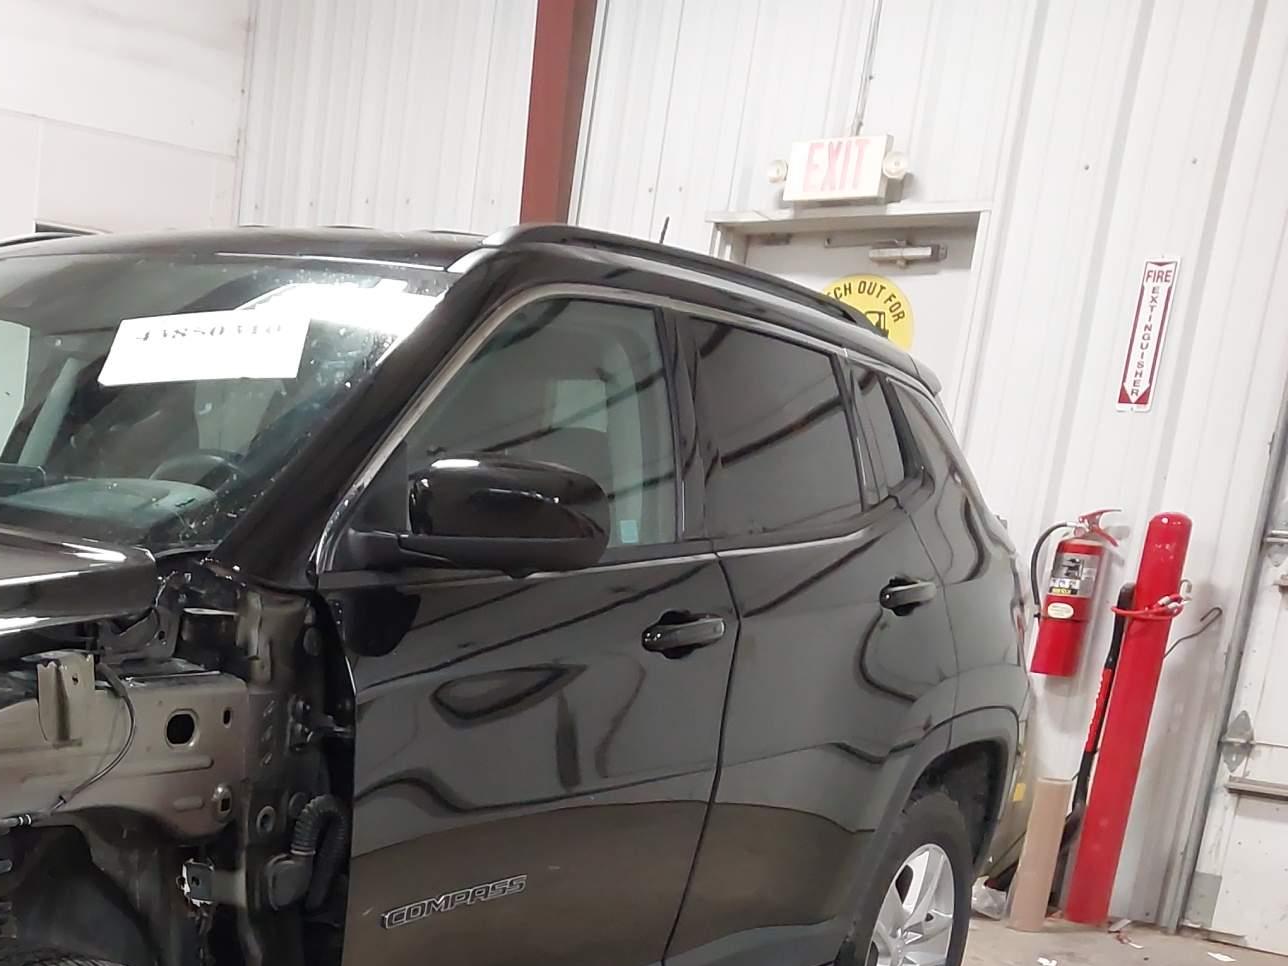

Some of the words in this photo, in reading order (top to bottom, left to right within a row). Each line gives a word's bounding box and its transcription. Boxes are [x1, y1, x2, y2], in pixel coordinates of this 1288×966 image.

[803, 139, 871, 193] EXIT
[858, 280, 886, 299] OUT
[884, 293, 906, 323] FOR
[1145, 270, 1172, 283] FIRE
[1130, 286, 1160, 397] EXTINGUISHER
[380, 874, 528, 929] COMPASS
